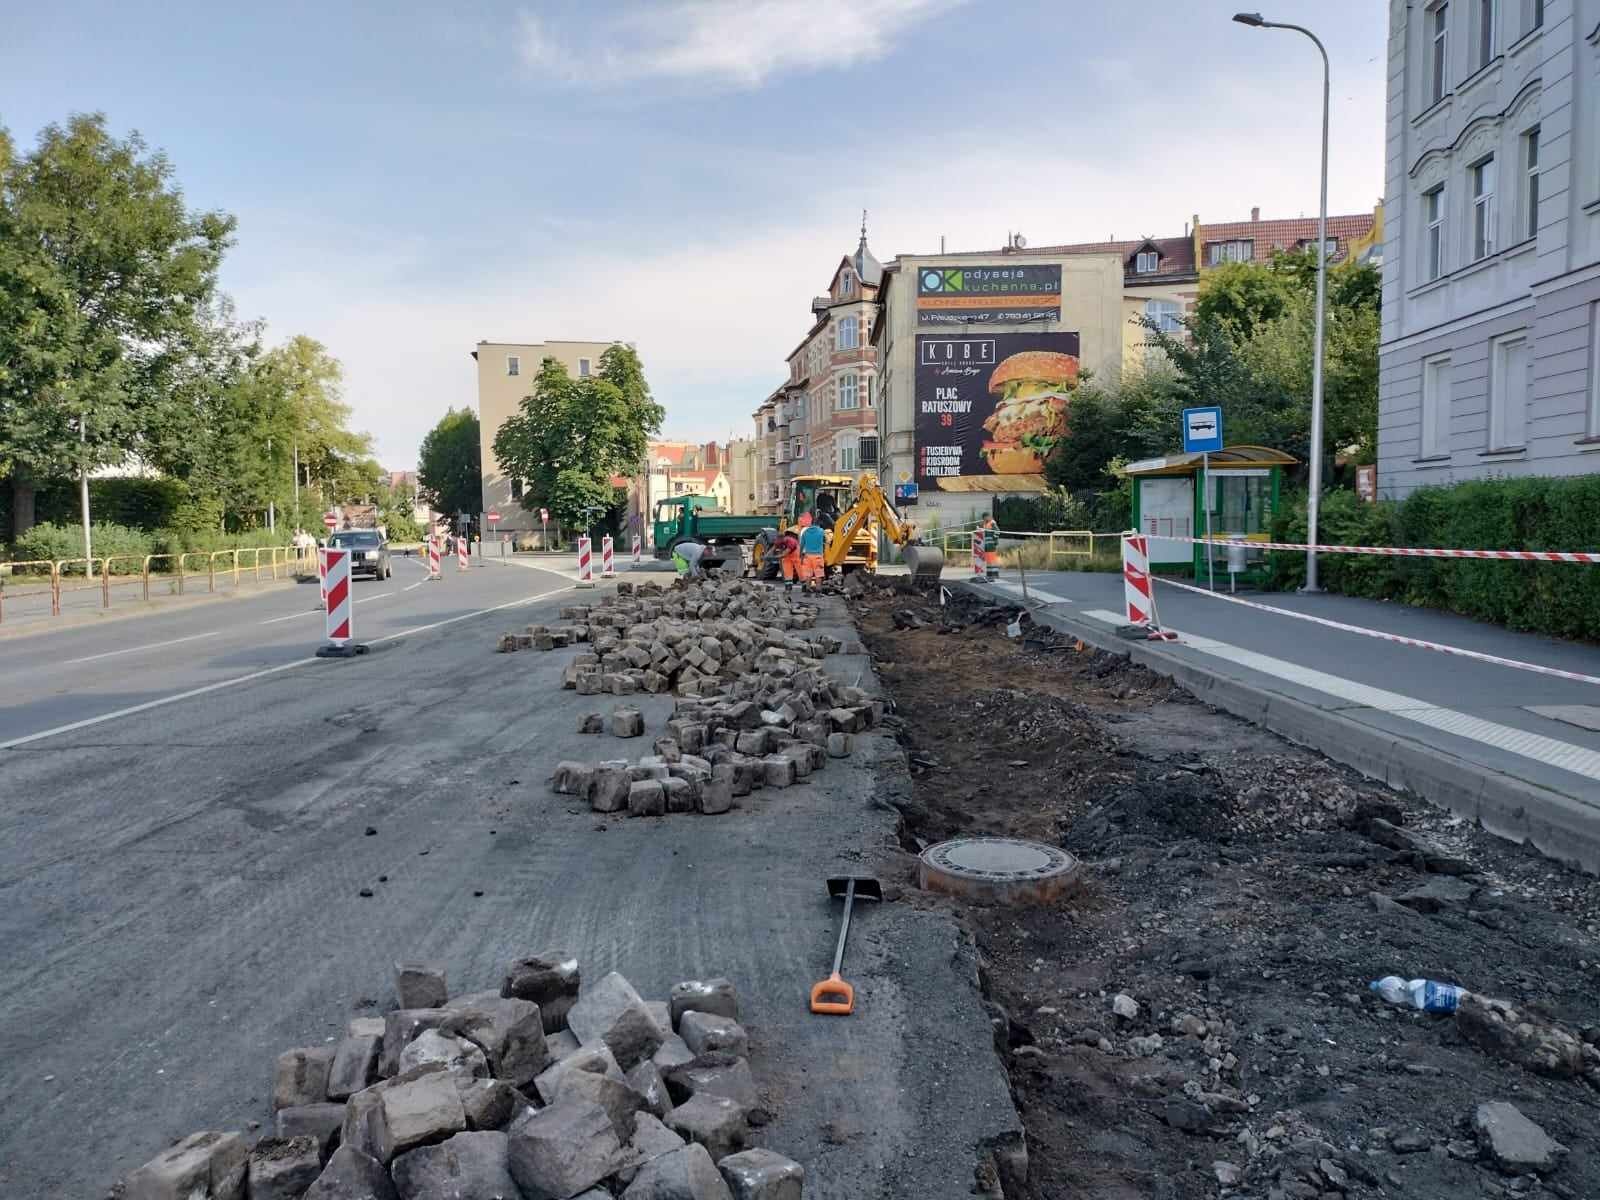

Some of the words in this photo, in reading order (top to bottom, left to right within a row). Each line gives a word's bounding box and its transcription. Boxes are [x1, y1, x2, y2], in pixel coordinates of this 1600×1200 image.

[964, 269, 1024, 280] odyseja
[929, 343, 989, 359] KOBE
[936, 387, 958, 399] PLAC
[922, 400, 972, 413] RATUSZOWY
[940, 414, 952, 426] 39
[842, 512, 857, 536] JCB
